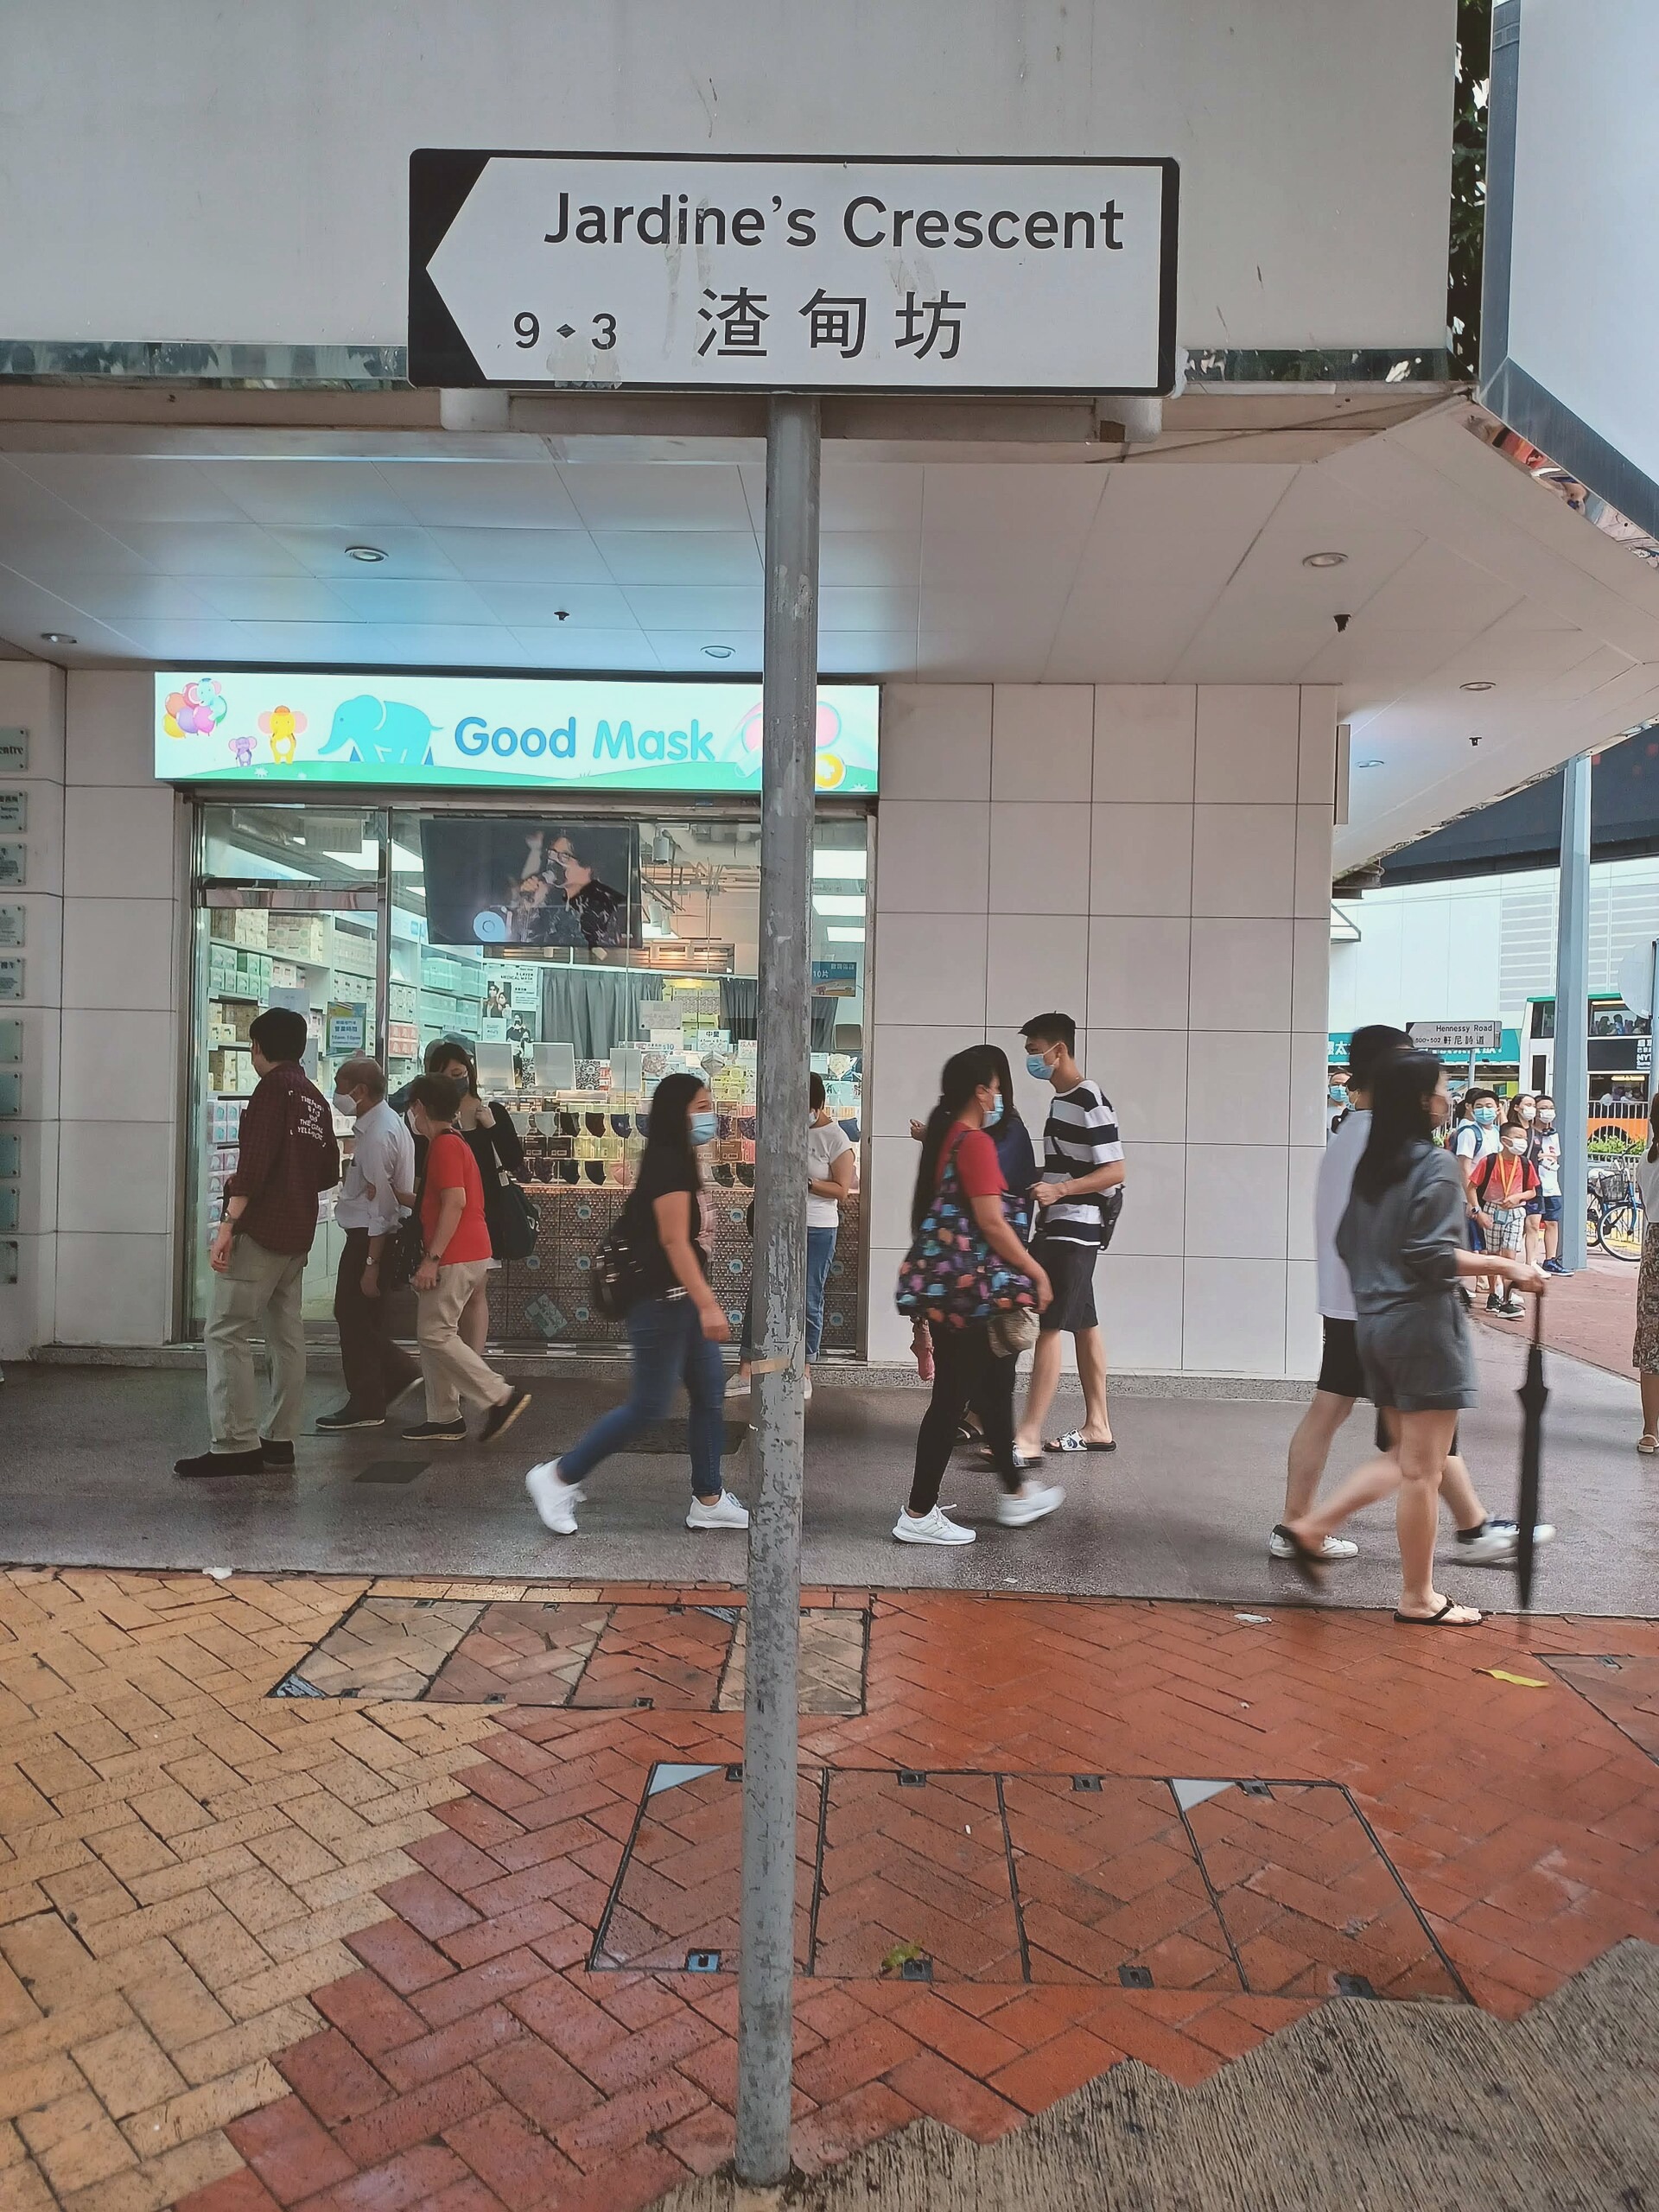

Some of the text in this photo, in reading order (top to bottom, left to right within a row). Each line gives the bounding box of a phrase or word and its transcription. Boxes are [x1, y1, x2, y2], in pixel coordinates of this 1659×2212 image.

[544, 193, 1124, 250] Jardine's Crescent
[513, 311, 617, 350] 9 3
[697, 286, 967, 360] 渣甸坊
[454, 716, 716, 761] Good Mask
[1435, 1024, 1471, 1033] Hennessy
[1443, 1035, 1484, 1046] 軒尼詩道
